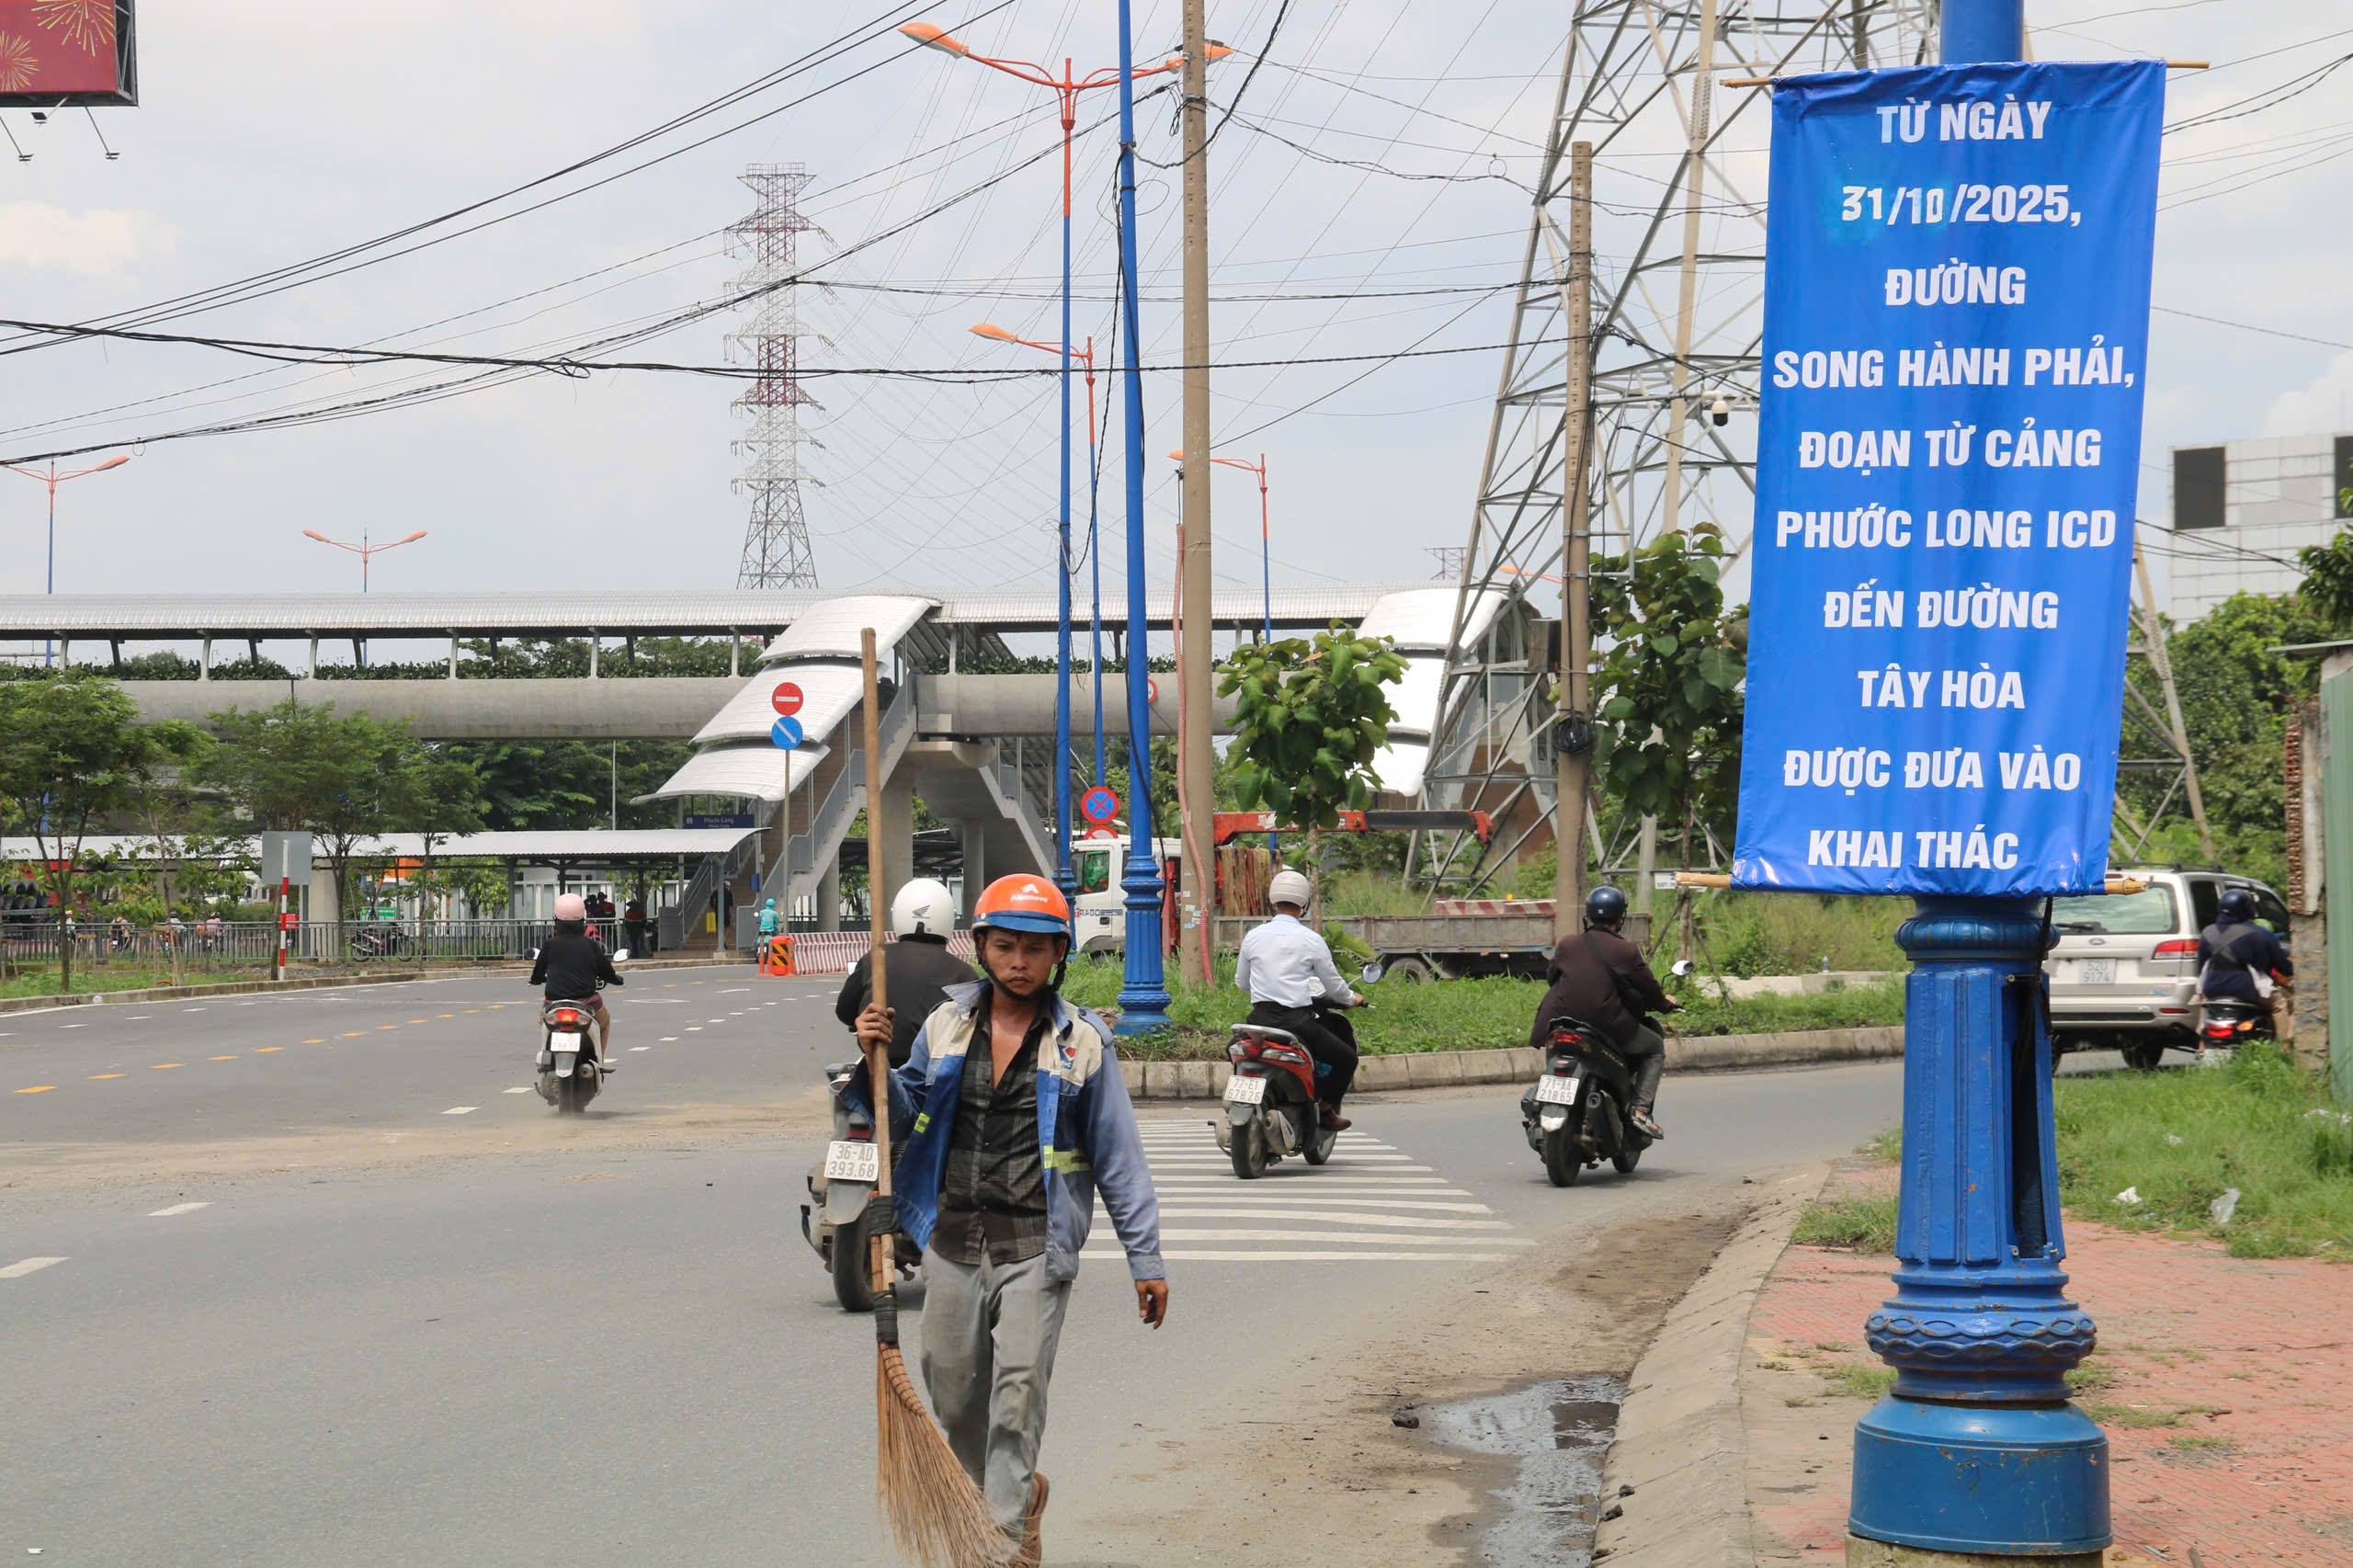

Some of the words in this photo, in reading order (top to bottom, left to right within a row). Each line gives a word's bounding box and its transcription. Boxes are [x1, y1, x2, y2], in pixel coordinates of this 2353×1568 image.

[1876, 97, 1931, 143] TỪ
[1939, 93, 2052, 142] NGÀY
[1841, 183, 2082, 227] 31/10/2025,
[1884, 256, 2027, 307] ĐƯỜNG
[1772, 349, 1884, 389] SONG
[1897, 340, 2010, 387] HÀNH
[2024, 334, 2134, 389] PHẢI,
[1798, 429, 1911, 476] ĐOẠN
[1924, 420, 1977, 468] TỪ
[1984, 416, 2102, 468] CẢNG
[1776, 502, 1913, 549] PHƯỚC
[1926, 508, 2032, 549] LONG
[2046, 509, 2117, 549] ICD
[1823, 578, 1904, 629] ĐẾN
[1916, 582, 2059, 630] ĐƯỜNG
[1857, 662, 1932, 709] TÂY
[1940, 662, 2026, 710] HÒA
[1783, 746, 1892, 796] ĐƯỢC
[1904, 746, 1984, 789] ĐƯA
[1998, 744, 2082, 791] VÀO
[1807, 829, 1904, 869] KHAI
[1915, 823, 2019, 870] THÁC
[829, 1161, 875, 1177] 393.68
[836, 1144, 874, 1162] 36-AD
